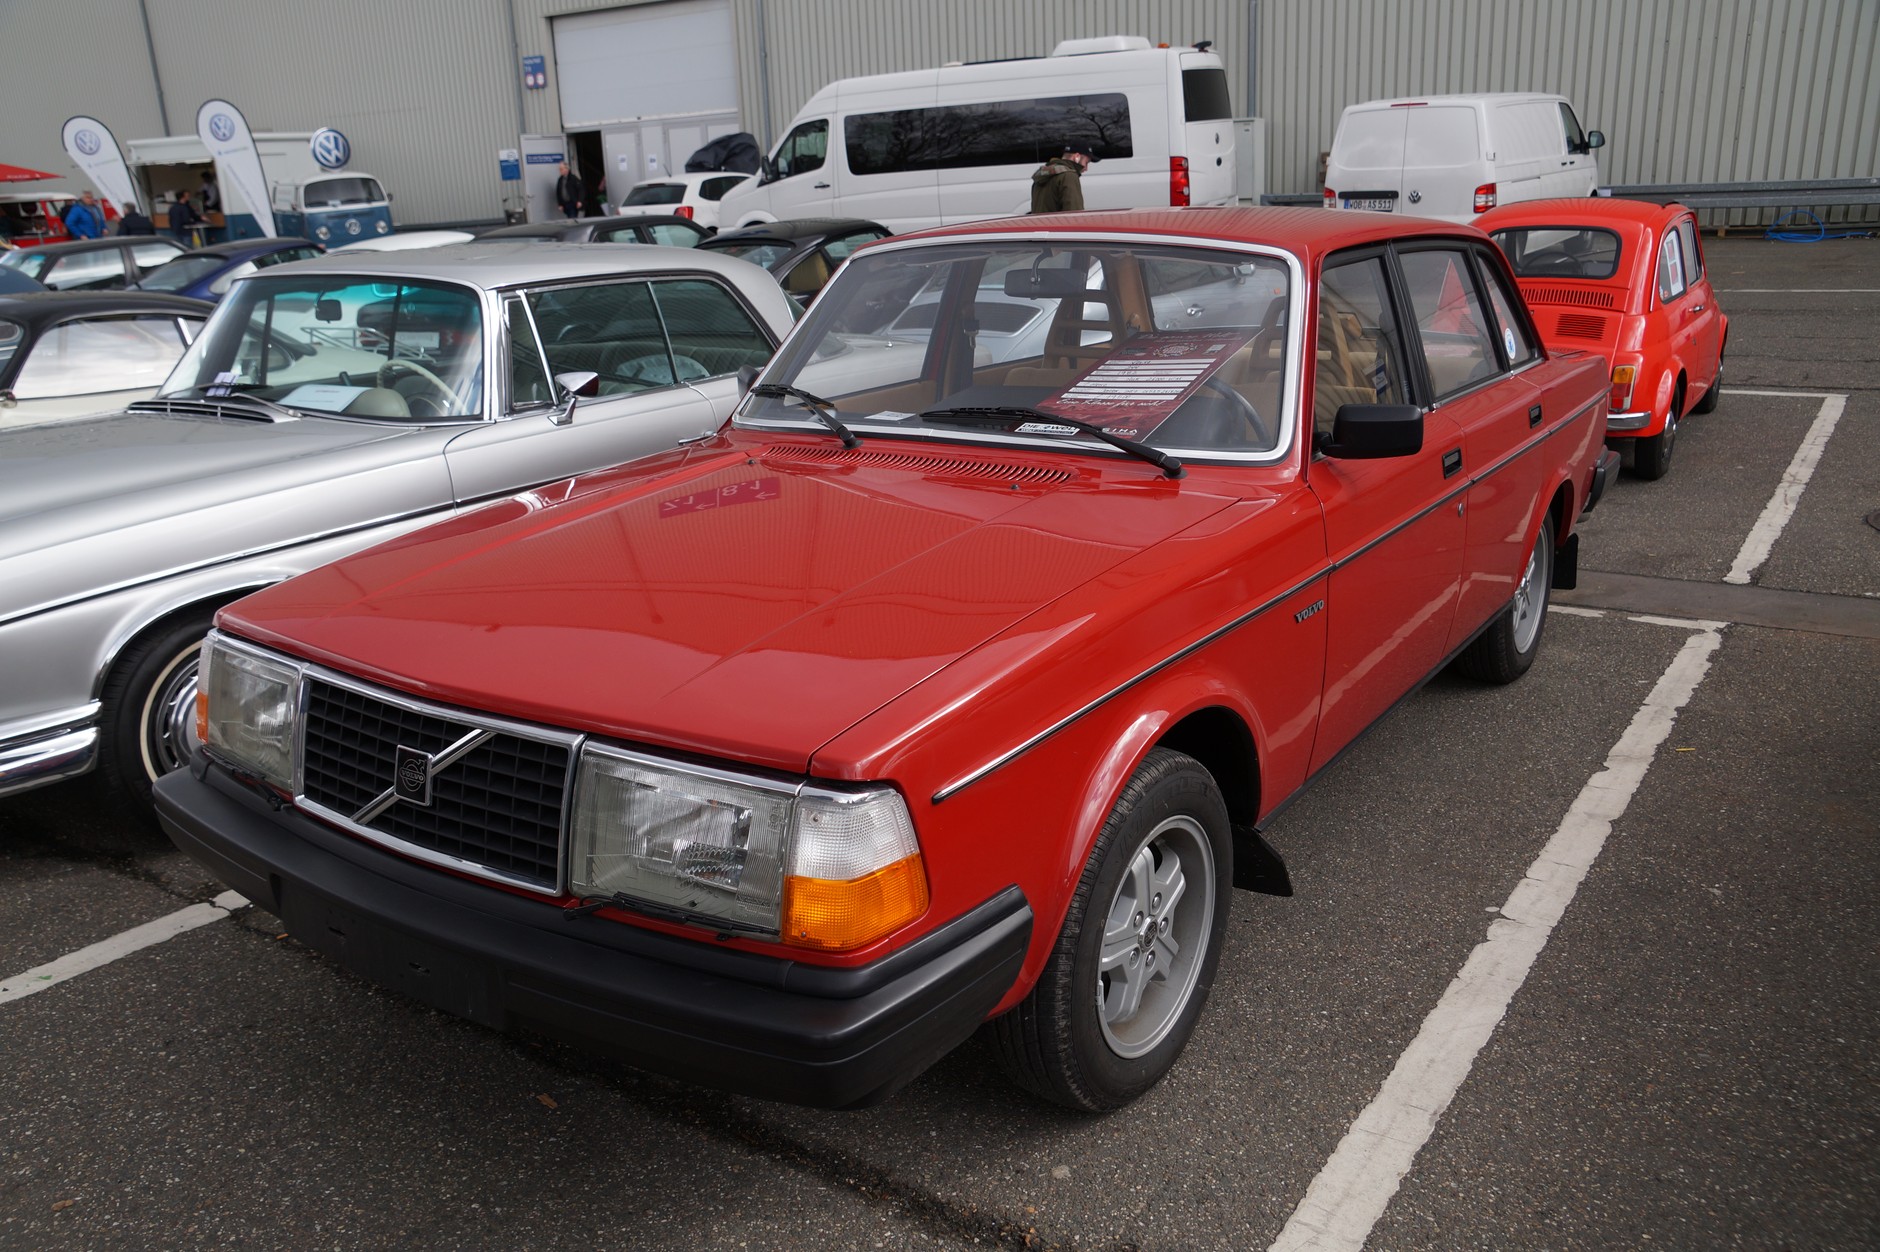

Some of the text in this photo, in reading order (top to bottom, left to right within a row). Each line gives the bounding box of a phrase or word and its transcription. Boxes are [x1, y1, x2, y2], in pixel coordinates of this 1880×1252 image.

[1367, 200, 1377, 209] AS
[1378, 200, 1391, 209] 511
[1296, 599, 1325, 623] VOLVO
[402, 769, 424, 781] VOLVO
